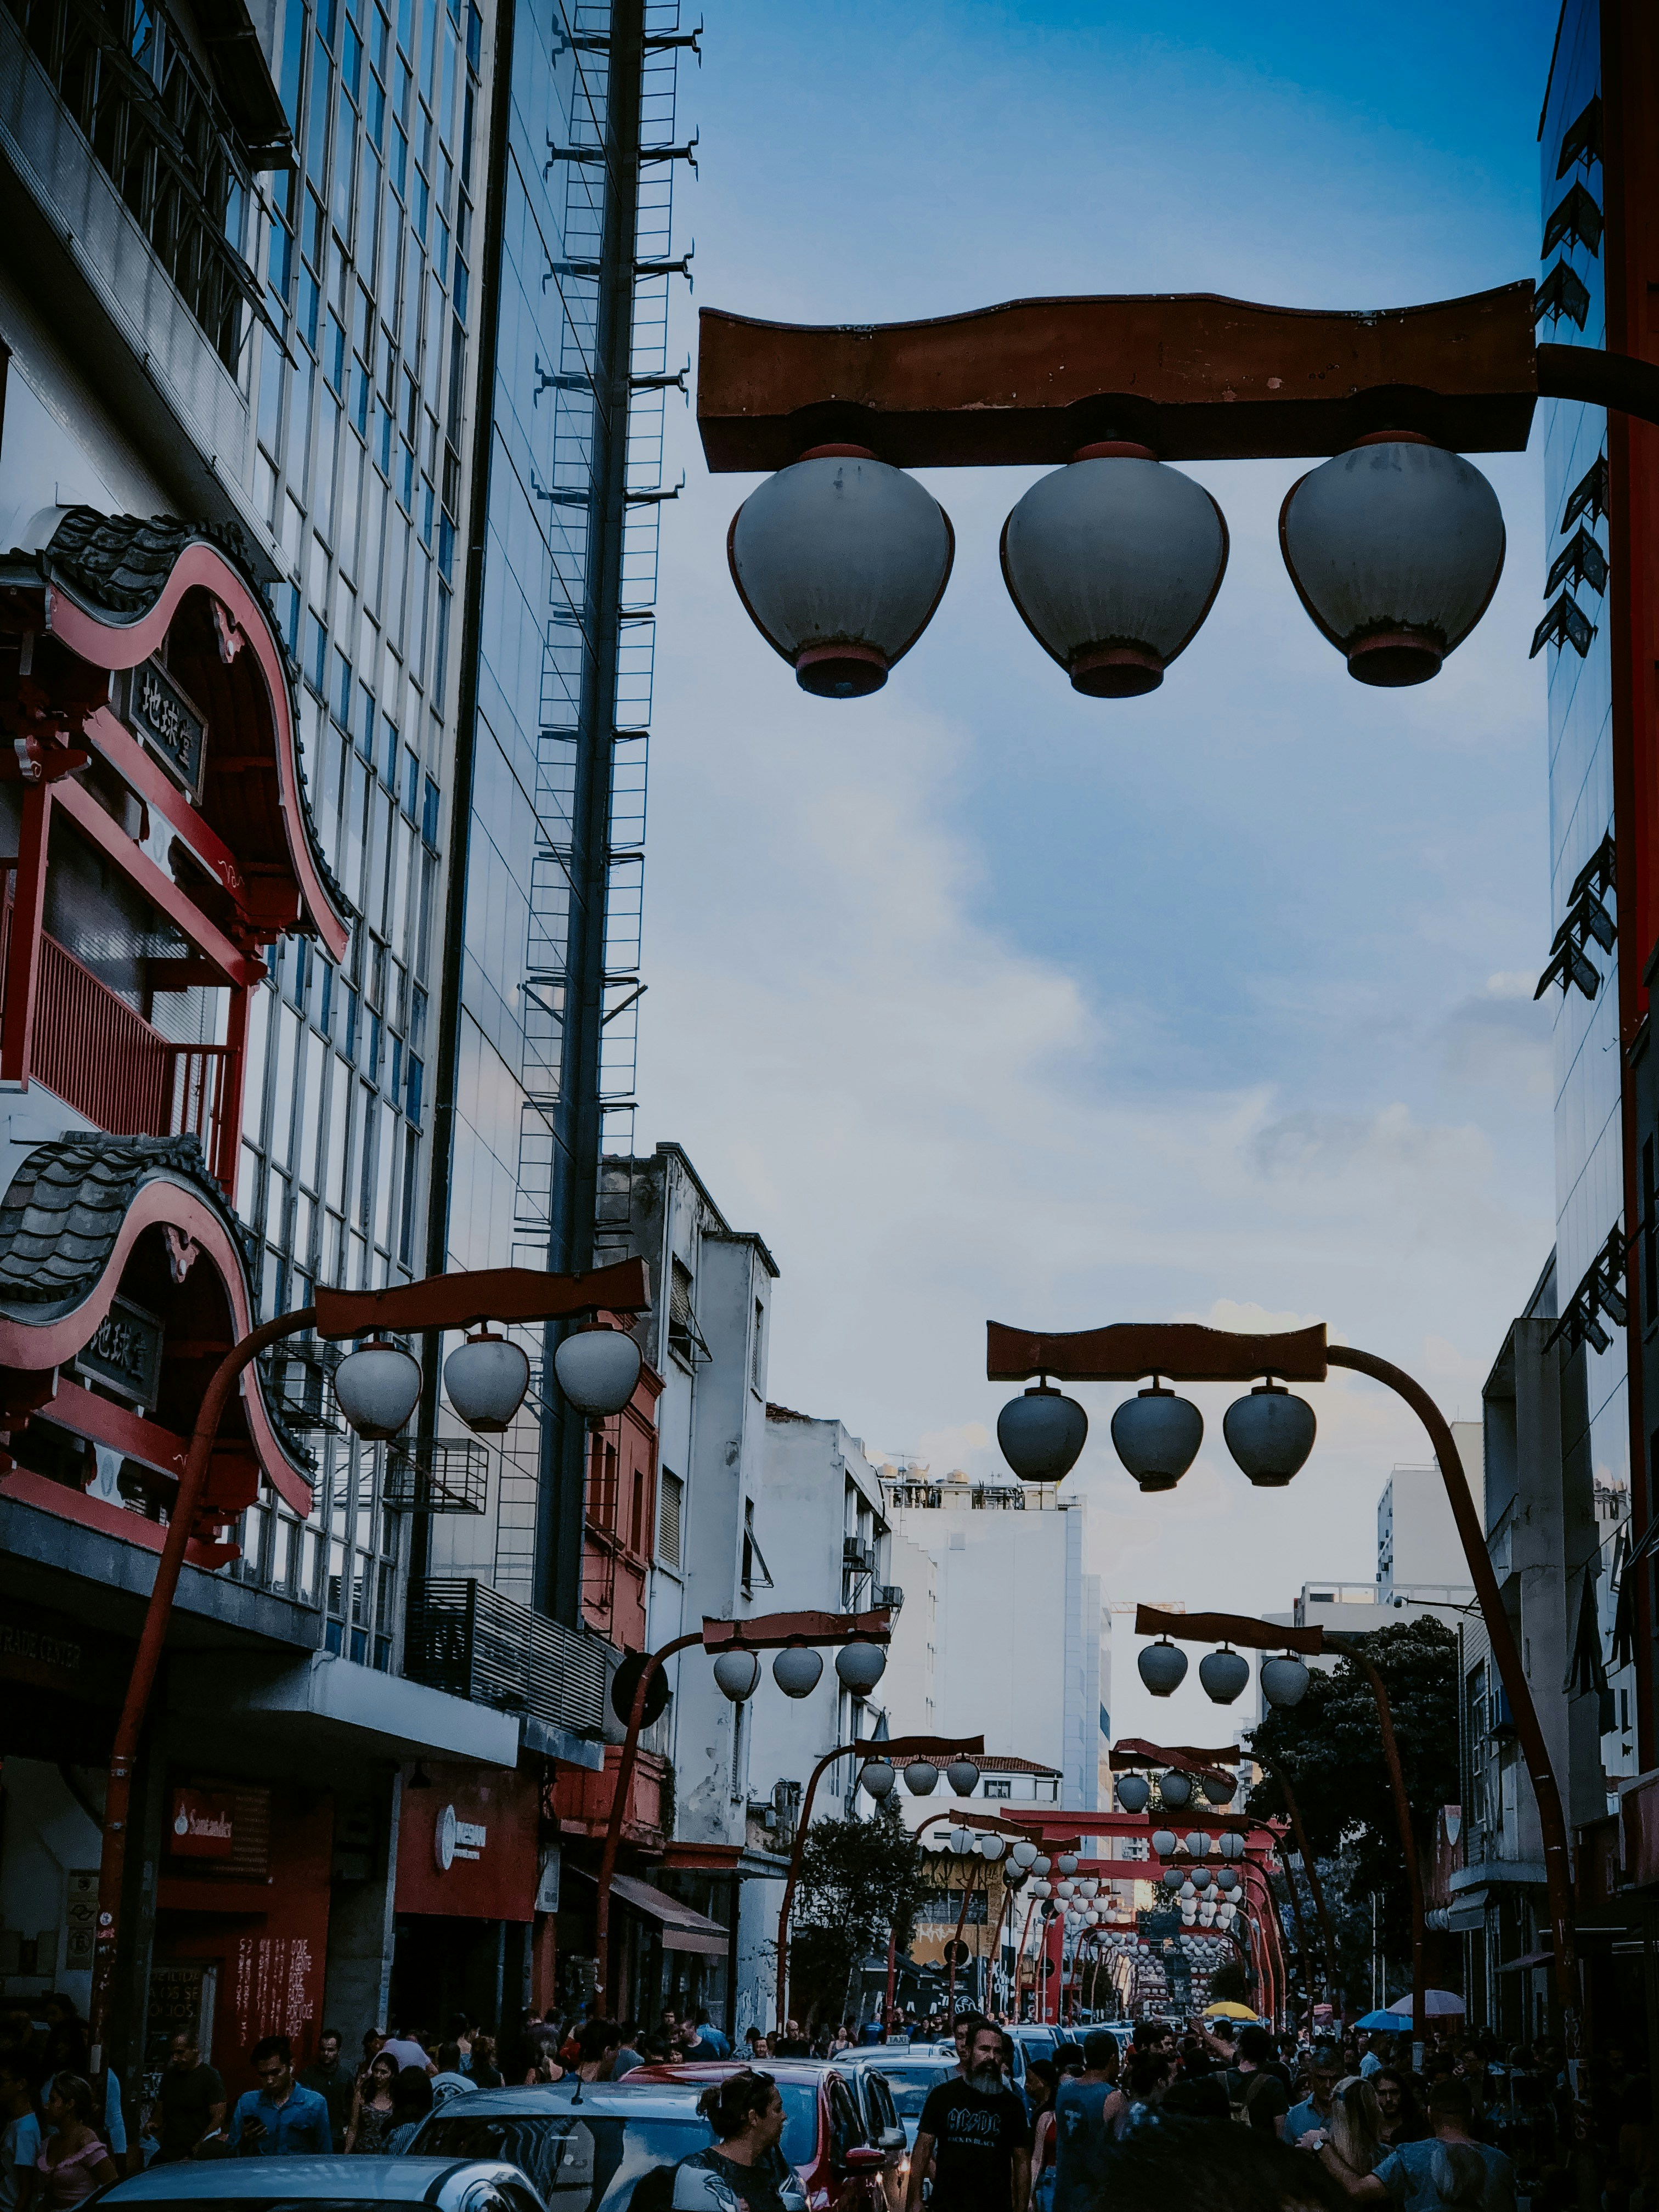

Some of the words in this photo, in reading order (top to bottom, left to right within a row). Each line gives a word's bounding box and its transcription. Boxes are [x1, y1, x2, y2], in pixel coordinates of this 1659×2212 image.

[142, 670, 194, 770] 地球堂
[89, 1318, 148, 1379] 地球堂
[0, 1625, 36, 1658] RADE
